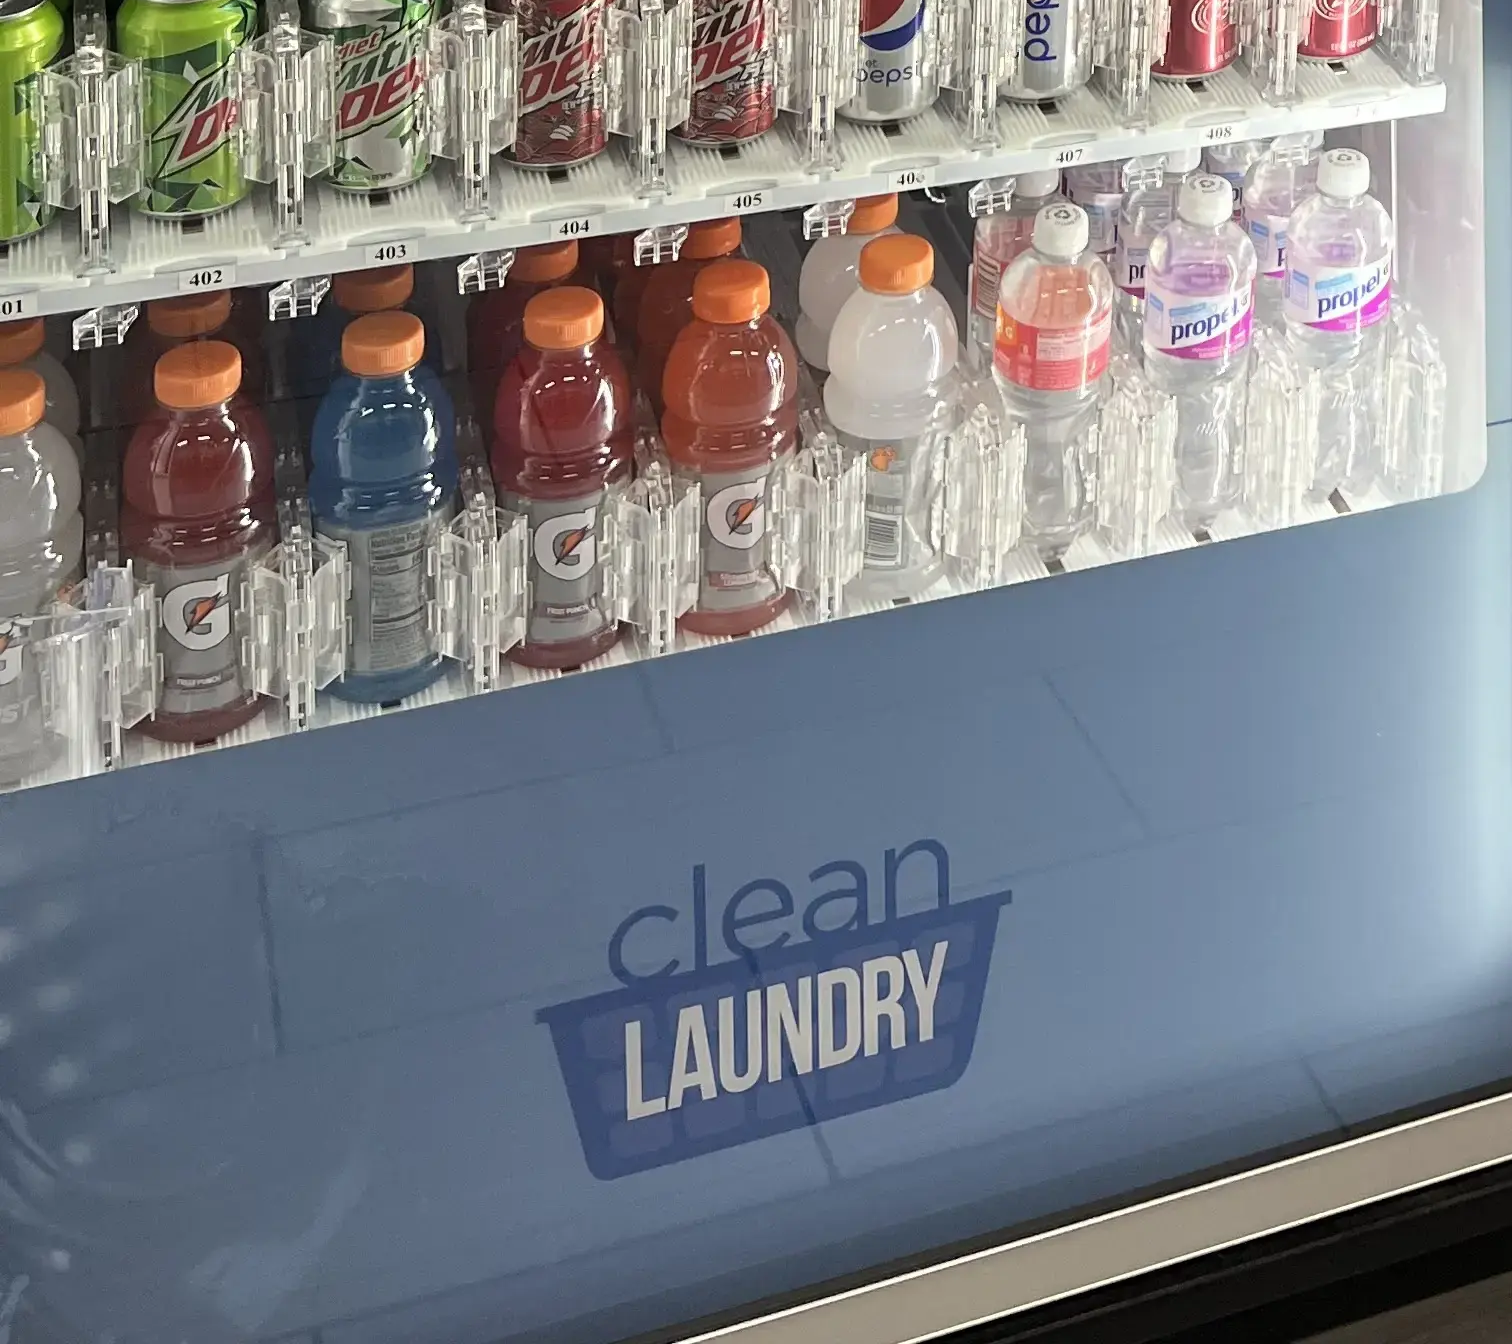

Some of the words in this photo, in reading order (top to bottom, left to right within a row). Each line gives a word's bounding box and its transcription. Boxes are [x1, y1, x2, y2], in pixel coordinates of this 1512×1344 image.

[1206, 125, 1233, 141] 408
[1056, 147, 1084, 165] 407
[732, 192, 763, 208] 405
[559, 219, 590, 235] 404
[374, 244, 407, 261] 403
[189, 269, 223, 287] 402
[1316, 266, 1382, 319] propel
[1, 298, 24, 316] 01
[1170, 297, 1239, 346] propel
[706, 475, 768, 550] G
[533, 505, 598, 581] G
[162, 573, 232, 651] G
[607, 838, 950, 985] clean
[625, 940, 949, 1122] LAUNDRY
